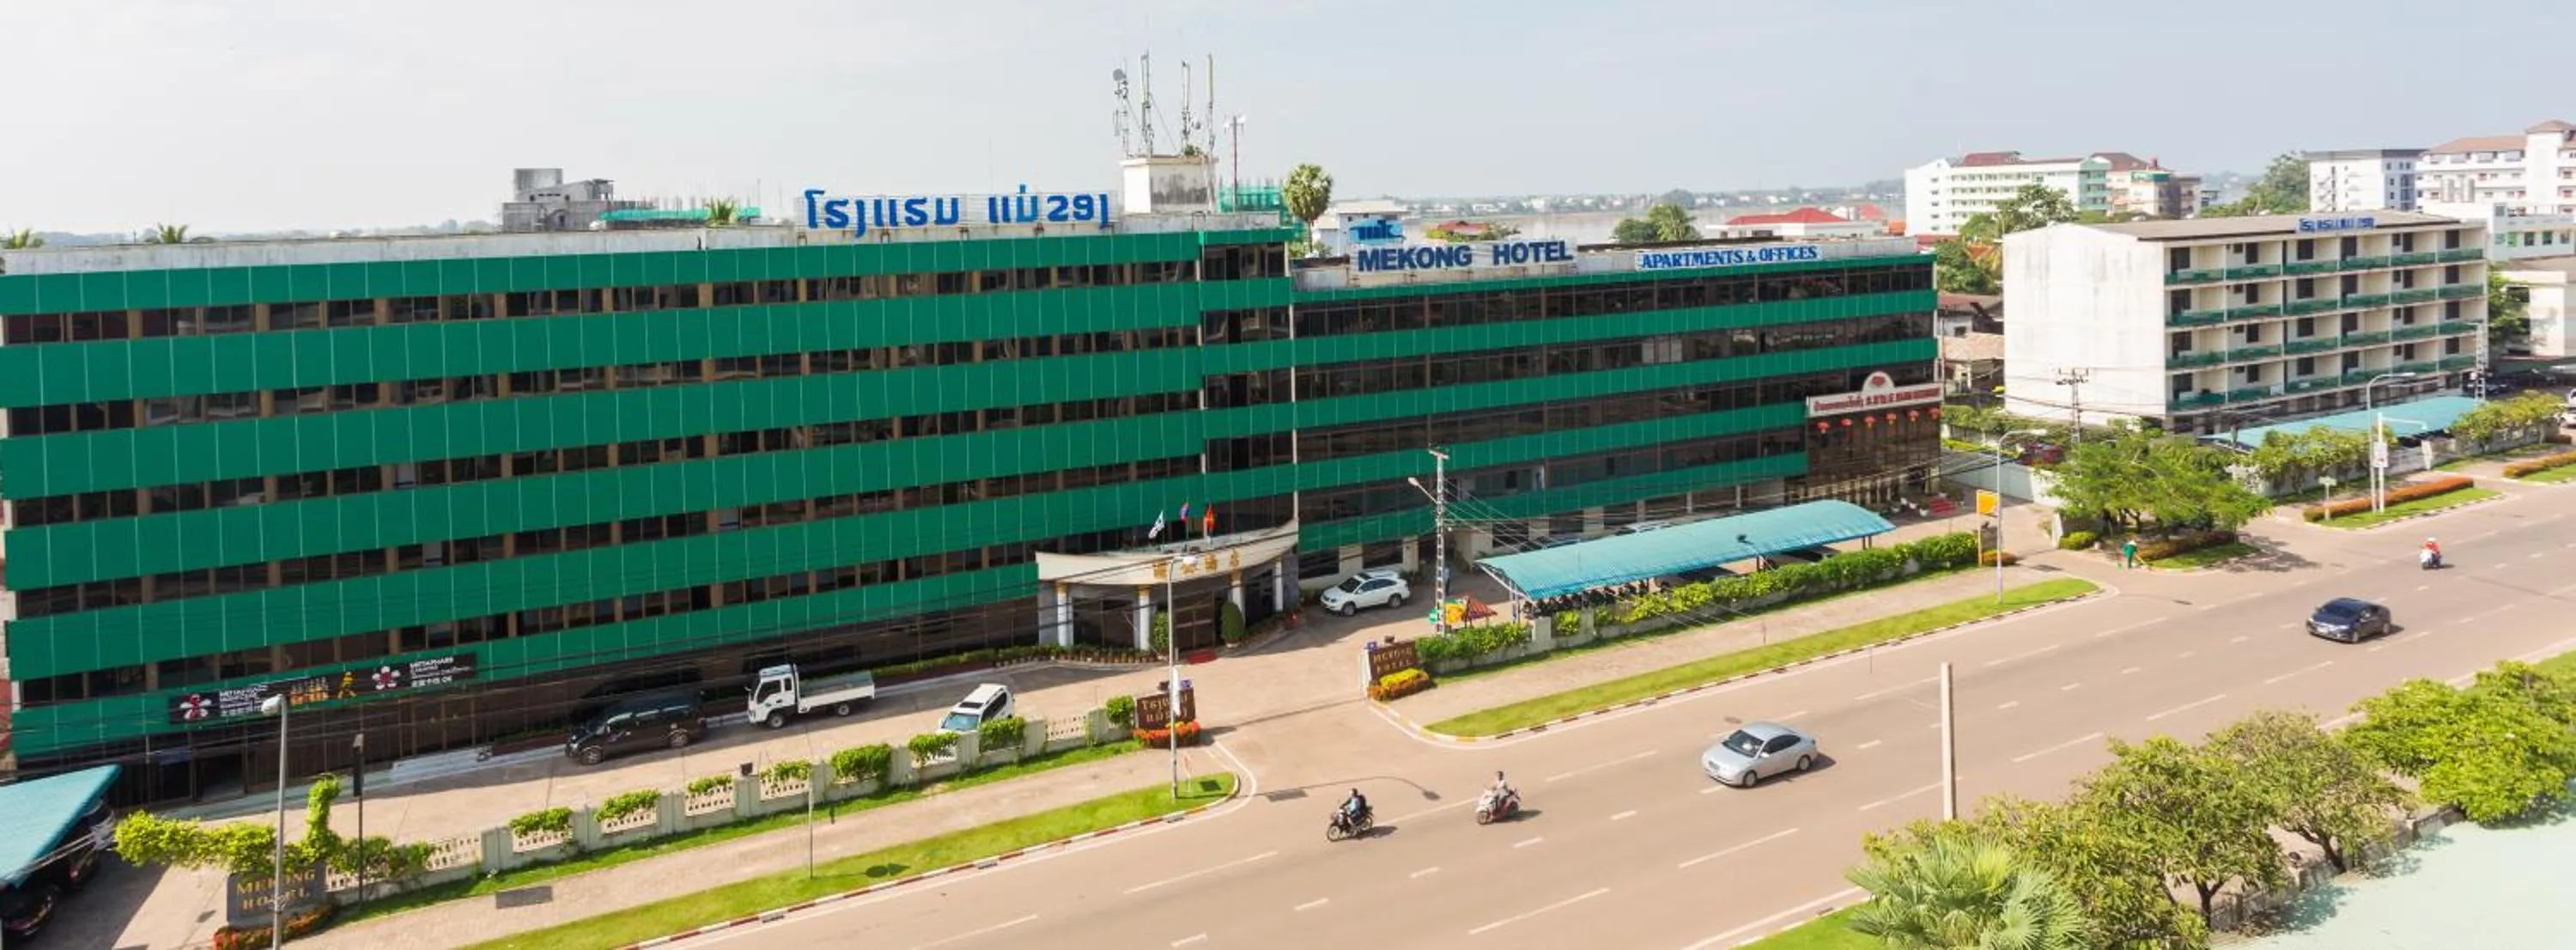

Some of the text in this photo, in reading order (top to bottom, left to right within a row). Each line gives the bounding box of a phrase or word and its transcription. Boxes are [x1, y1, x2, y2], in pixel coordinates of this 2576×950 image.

[1358, 241, 1573, 272] MEKONG HOTEL
[1639, 245, 1818, 269] APARTMENTS & OFFICES
